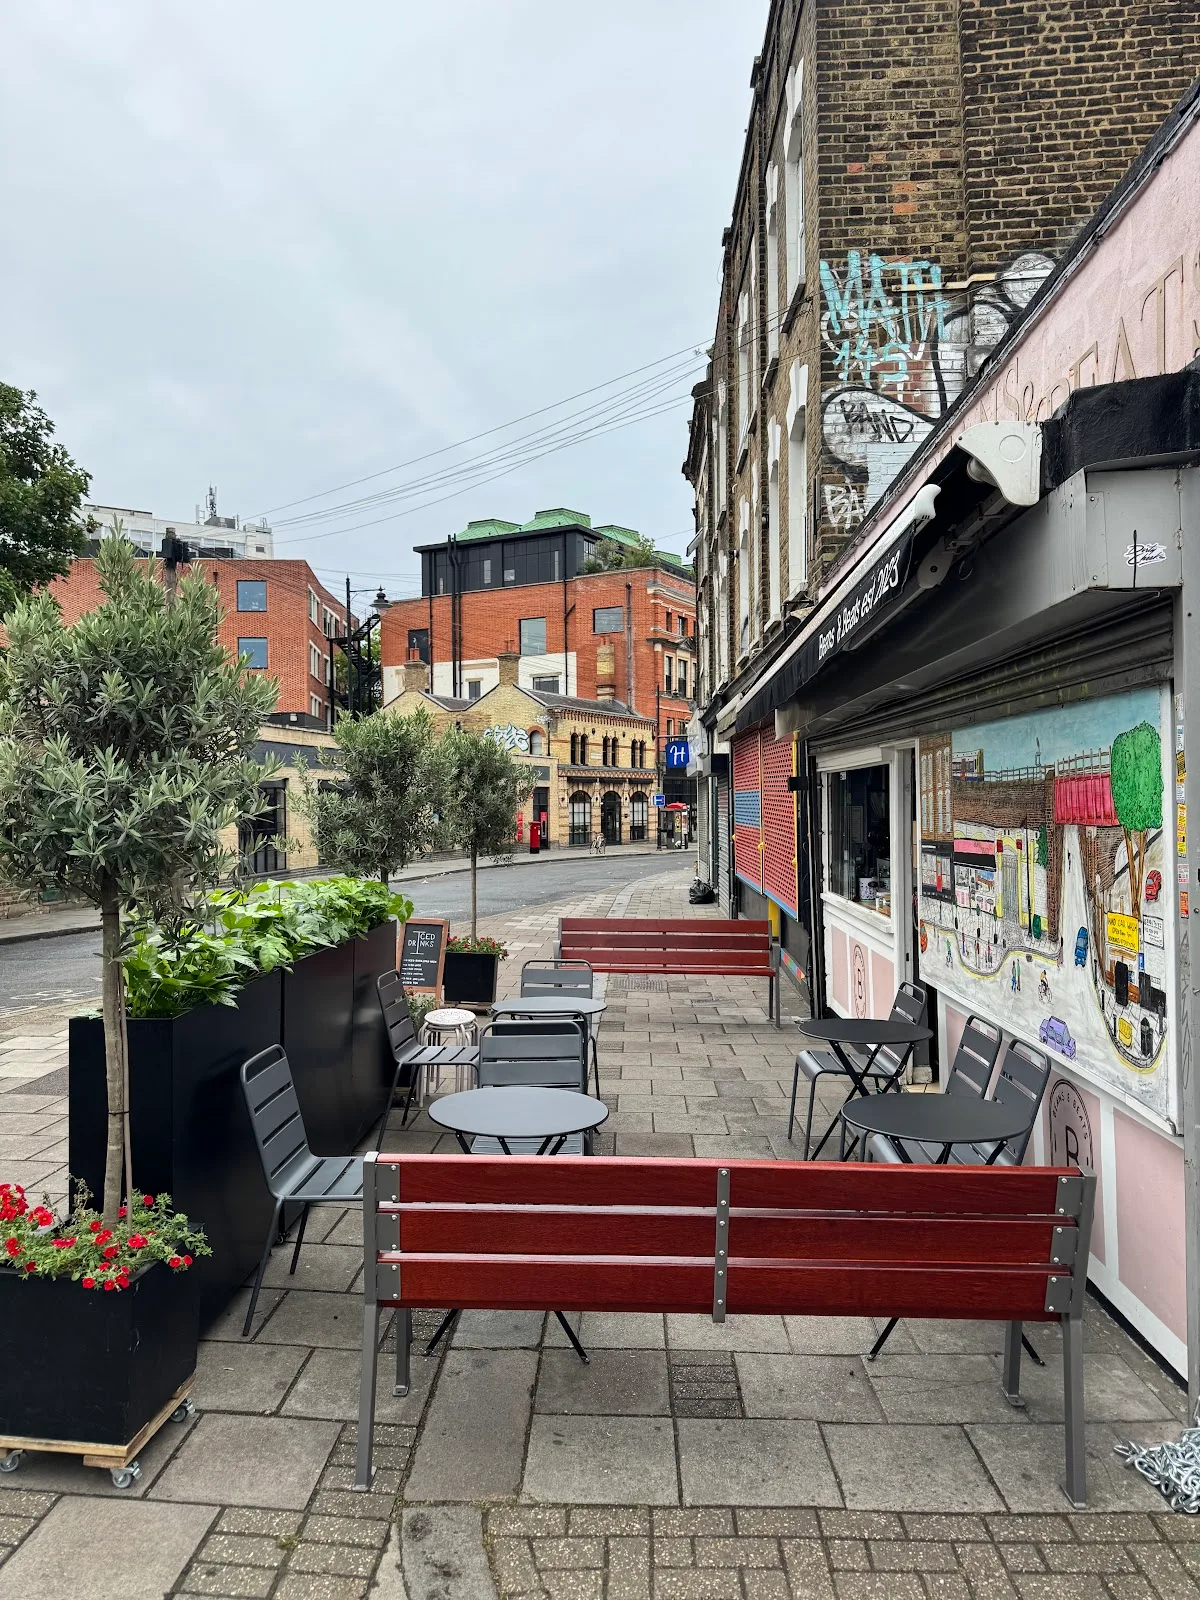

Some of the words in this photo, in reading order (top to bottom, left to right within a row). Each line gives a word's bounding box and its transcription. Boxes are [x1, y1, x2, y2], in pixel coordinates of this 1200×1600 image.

[818, 628, 835, 660] Beans
[836, 614, 842, 643] &
[841, 596, 861, 638] Beats
[861, 577, 876, 618] est
[873, 550, 900, 606] 2023
[670, 745, 686, 766] H
[1052, 1091, 1065, 1118] BEANS
[1072, 1099, 1089, 1140] BEATS
